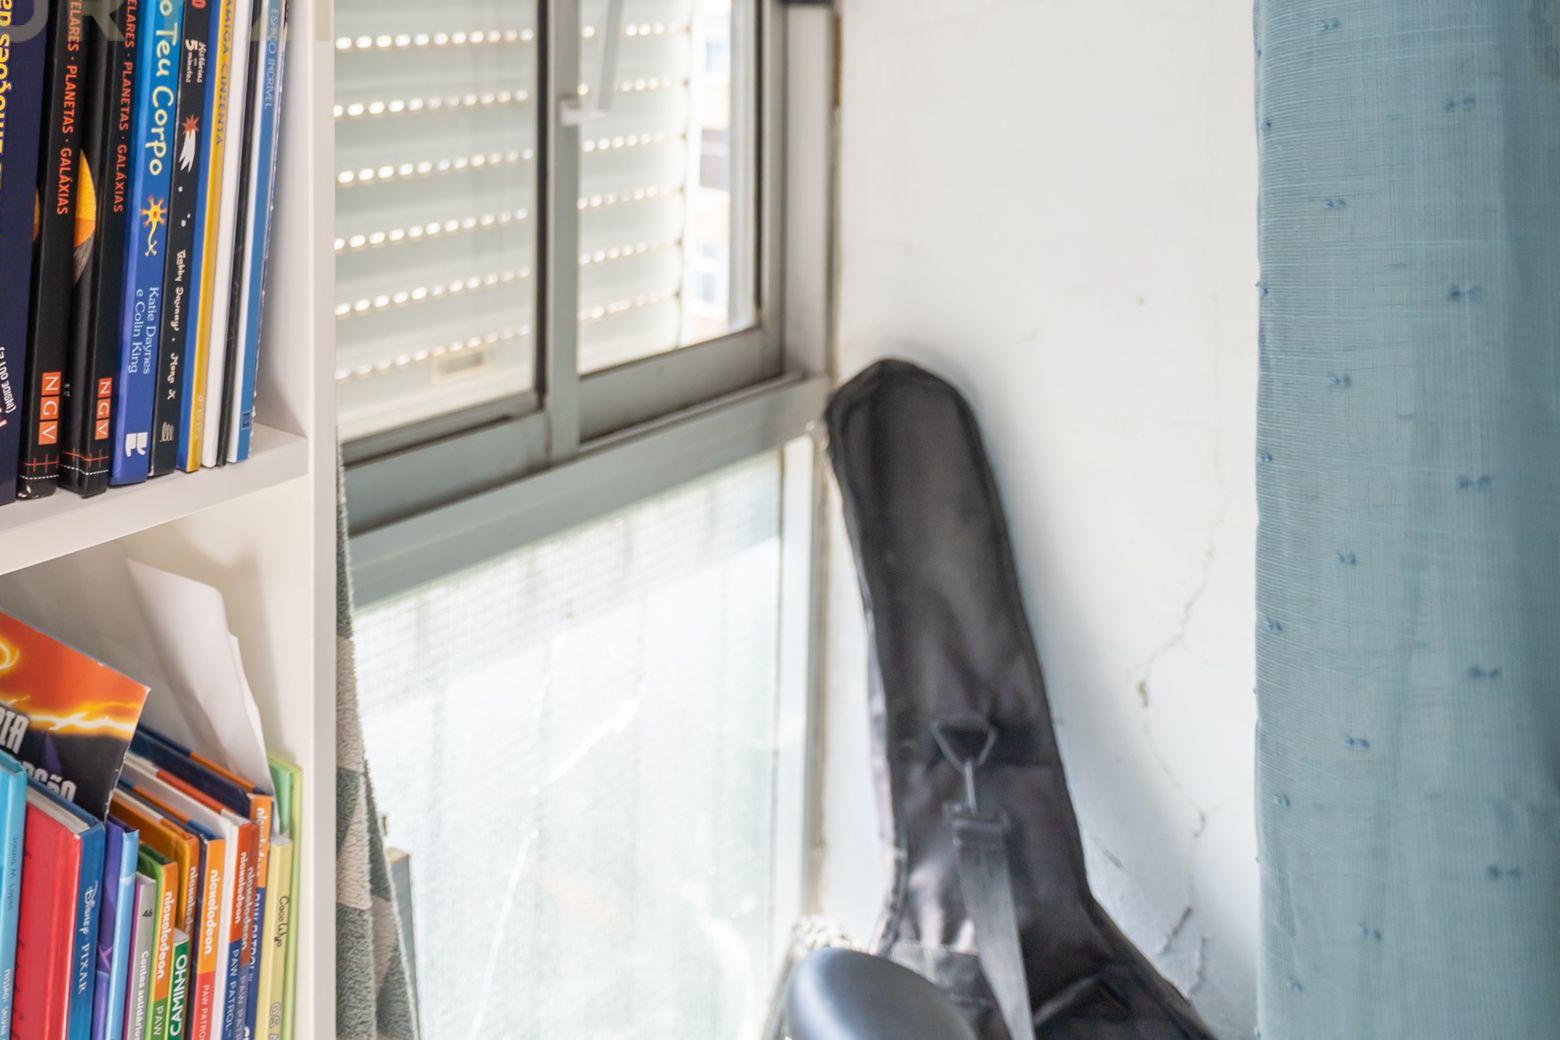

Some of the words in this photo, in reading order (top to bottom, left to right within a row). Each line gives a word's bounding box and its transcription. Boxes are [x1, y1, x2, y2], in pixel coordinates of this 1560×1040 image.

[155, 22, 179, 77] Teu
[185, 39, 198, 50] 5
[62, 65, 77, 134] PLANETAS
[119, 61, 133, 130] PLANETAS
[145, 86, 174, 175] Corpo
[57, 147, 72, 215] GALÁXIAS
[113, 144, 128, 213] GALÁXIAS
[132, 302, 145, 337] Colin
[147, 287, 159, 321] Katie
[128, 342, 143, 373] King
[143, 326, 156, 375] Daynes
[2, 380, 16, 413] (INSIDE
[158, 891, 172, 980] nickelodeon
[204, 869, 218, 955] nickelodeon
[153, 1006, 164, 1036] PAW
[170, 954, 188, 1036] CAMINHO
